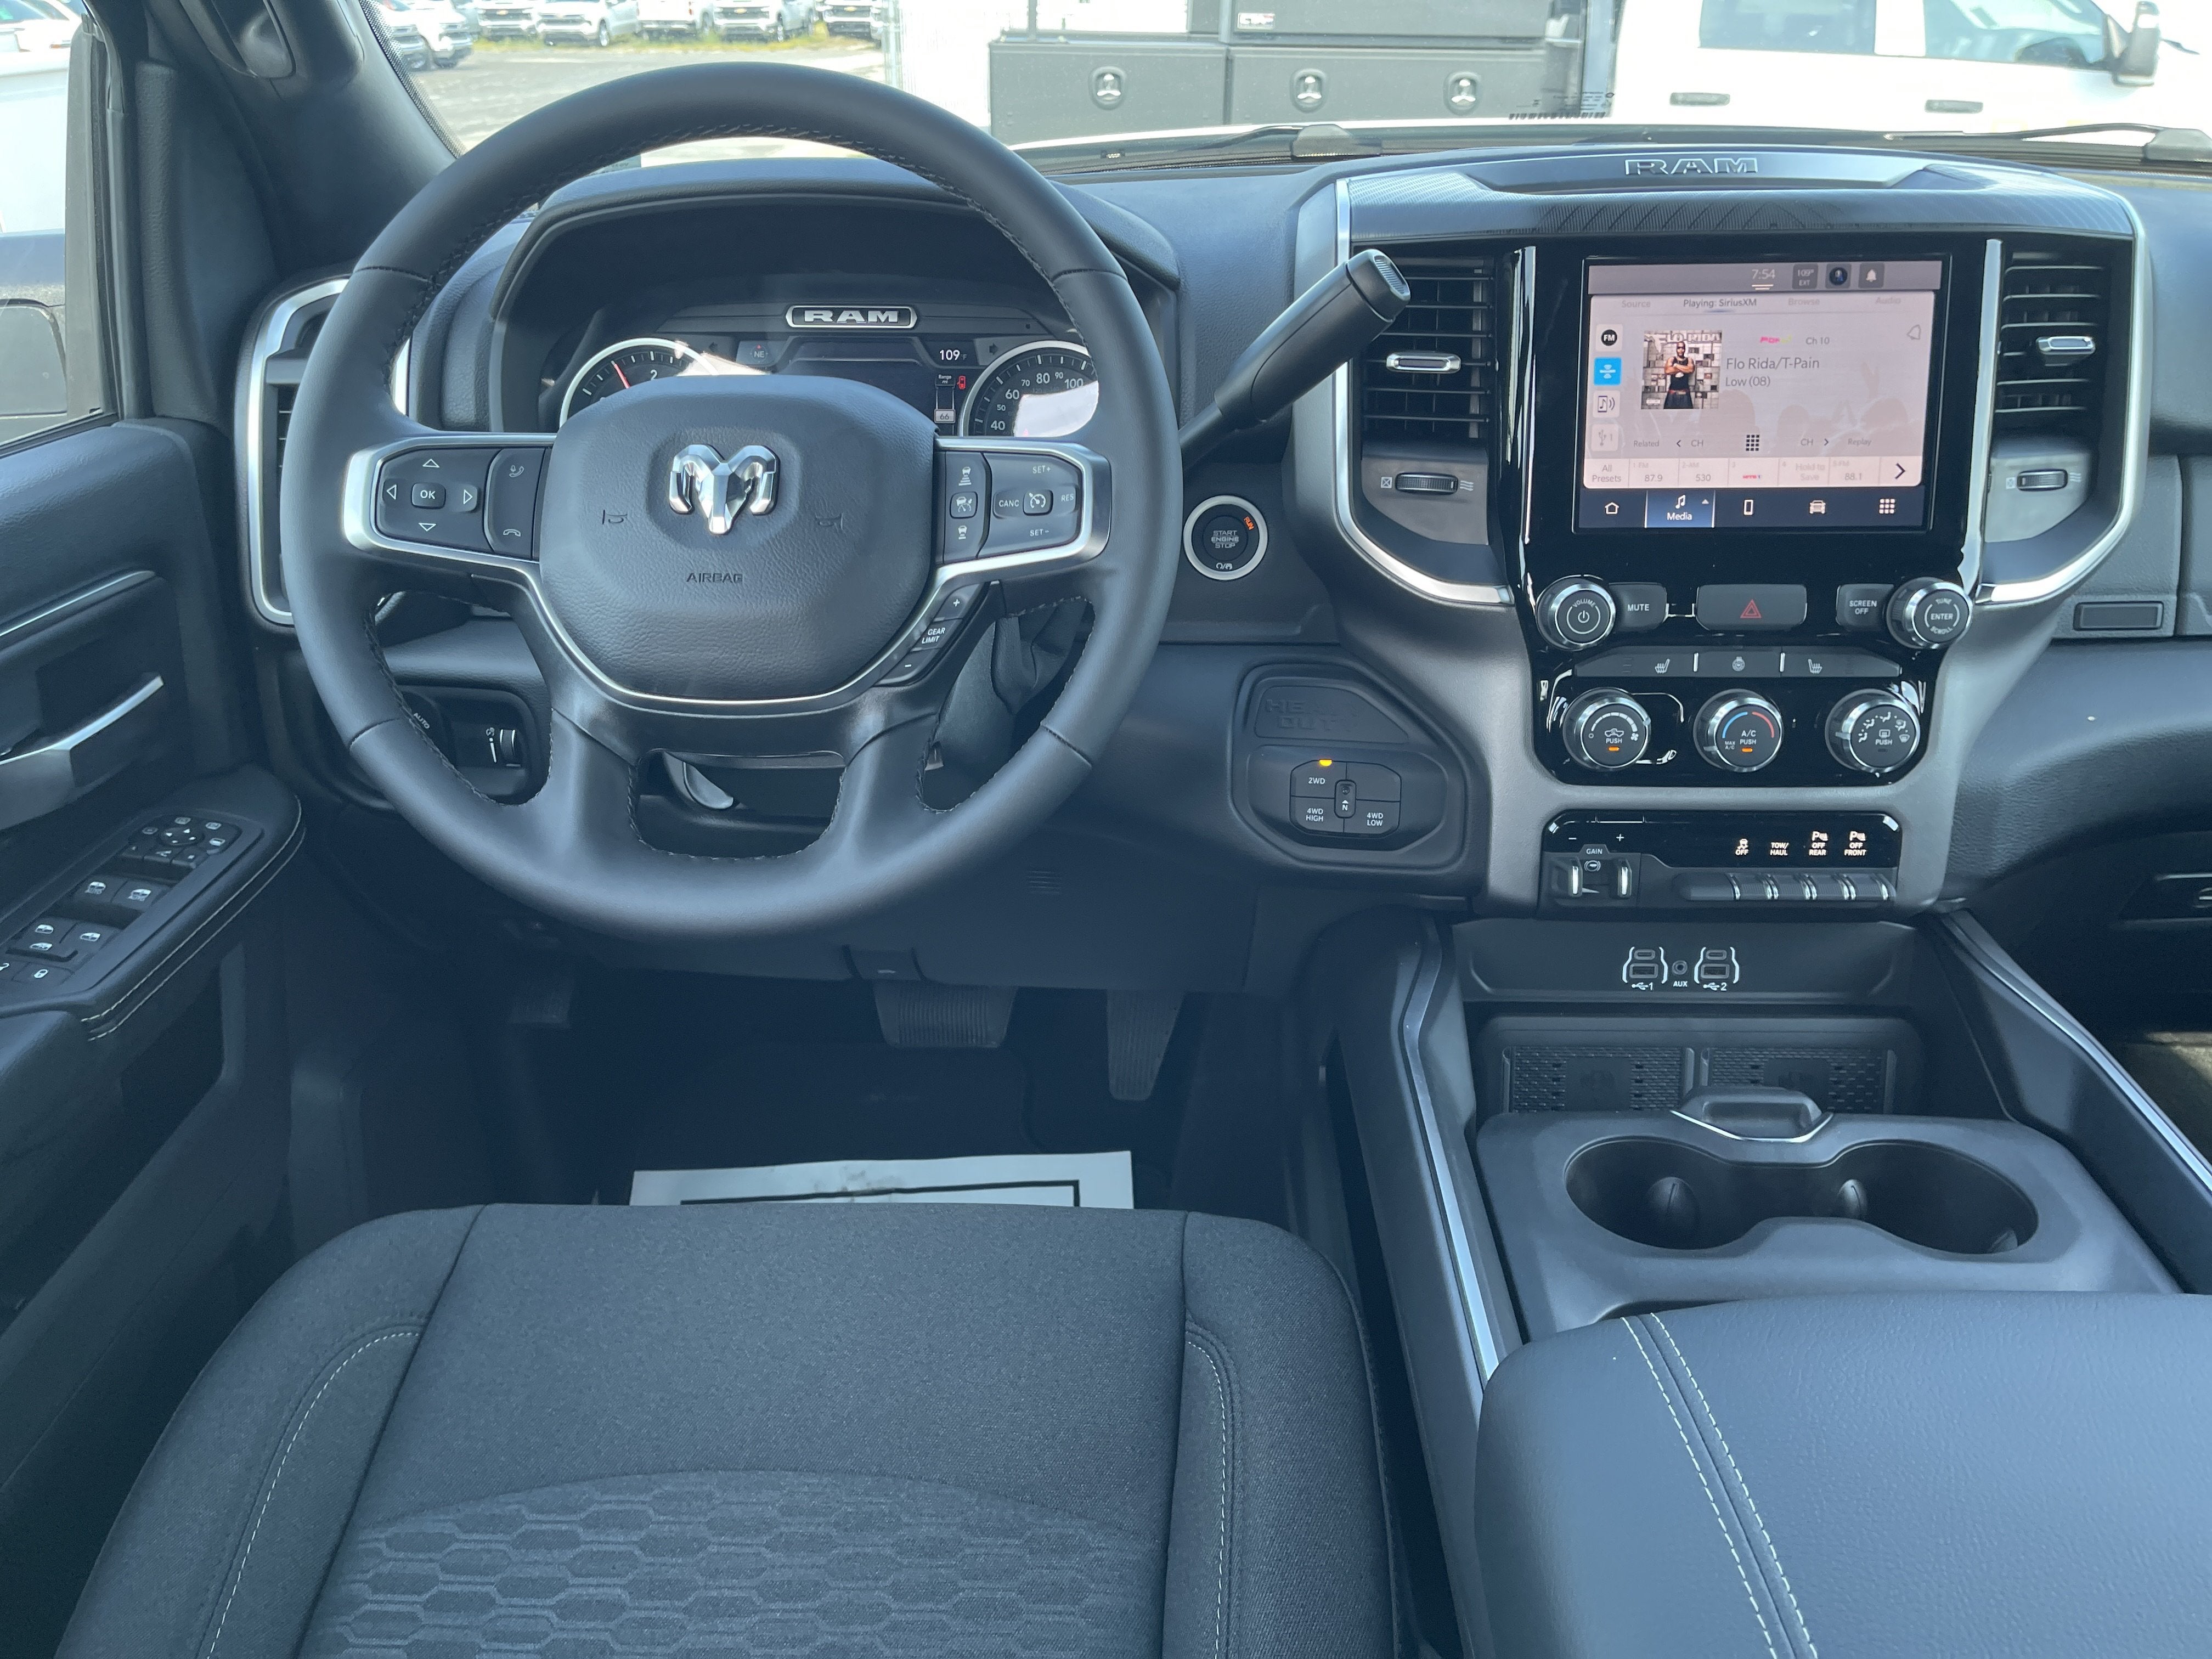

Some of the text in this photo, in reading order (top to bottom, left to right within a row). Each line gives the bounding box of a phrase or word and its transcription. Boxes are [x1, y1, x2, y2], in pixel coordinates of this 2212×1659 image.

[1624, 157, 1758, 176] RAM
[1752, 269, 1776, 280] 7:54
[1622, 300, 1651, 308] Source
[1719, 298, 1757, 307] SiriusXM
[804, 310, 899, 323] RAM
[1805, 337, 1830, 345] Ch 10
[1726, 357, 1820, 371] Flo Rida/T-Pain
[1036, 372, 1051, 384] 80
[1725, 376, 1771, 387] Low (08)
[1064, 378, 1084, 390] 100
[1005, 389, 1020, 400] 60
[990, 420, 1006, 431] 40
[1633, 439, 1660, 448] Related
[1848, 438, 1872, 447] Replay
[1592, 474, 1622, 482] Presets
[1844, 473, 1862, 481] 88.1
[420, 490, 436, 500] OK
[998, 499, 1019, 507] CANC
[1667, 512, 1692, 521] Media
[1243, 516, 1255, 531] RUN
[686, 573, 744, 583] AIRBAG
[1572, 598, 1596, 608] VOLUME
[1627, 603, 1650, 612] MUTE
[927, 627, 946, 636] GEAR
[1930, 625, 1953, 635] SCROLL
[922, 636, 940, 644] LIMIT
[413, 713, 431, 730] AUTO
[1720, 982, 1727, 991] 2
